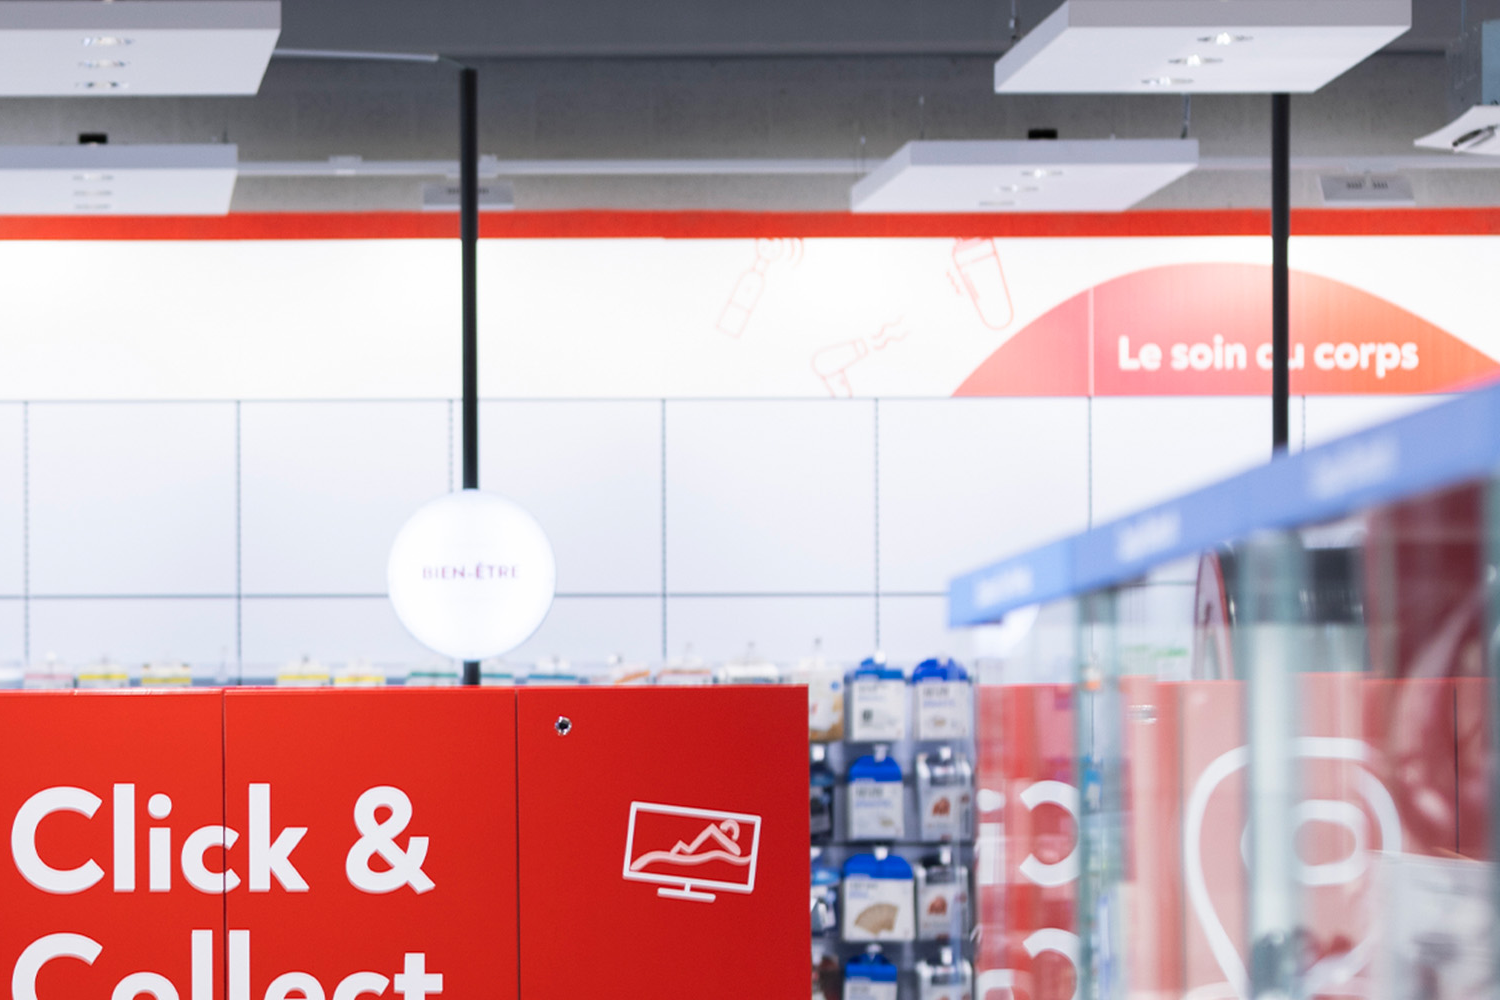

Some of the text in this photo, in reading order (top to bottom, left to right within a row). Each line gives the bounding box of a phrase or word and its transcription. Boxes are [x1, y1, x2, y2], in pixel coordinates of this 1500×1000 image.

[1118, 335, 1163, 371] Le
[1170, 334, 1248, 371] soin
[1313, 342, 1419, 379] corps
[10, 782, 437, 896] Click &
